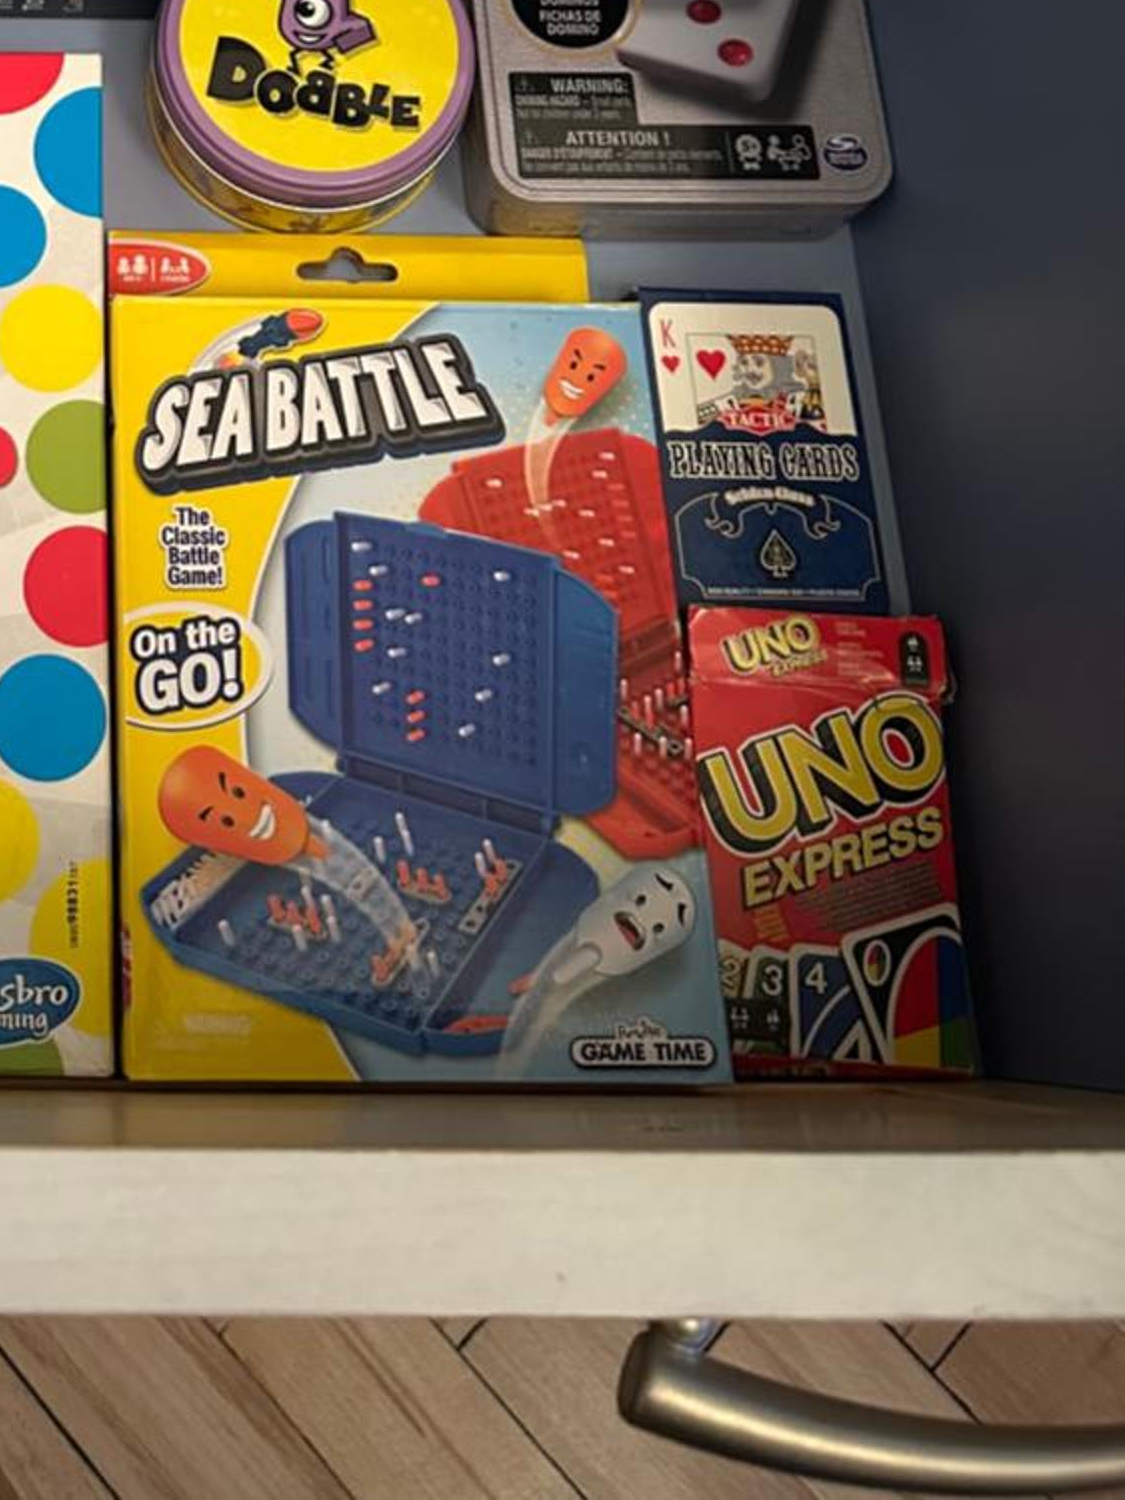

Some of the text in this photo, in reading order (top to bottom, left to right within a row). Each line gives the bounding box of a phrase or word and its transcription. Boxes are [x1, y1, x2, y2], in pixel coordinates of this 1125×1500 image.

[566, 131, 659, 146] ATTENTION
[660, 320, 675, 348] K
[142, 341, 487, 472] SEA BATTLE
[728, 411, 795, 428] TACTIC
[668, 441, 859, 481] PLAYING CARDS
[175, 507, 209, 525] The
[162, 526, 225, 545] Classic
[168, 546, 220, 565] Battle
[168, 566, 223, 585] Game!
[132, 618, 236, 660] On the
[722, 614, 816, 672] UNO
[138, 648, 241, 712] GO!
[699, 693, 944, 853] UNO
[744, 807, 944, 906] EXPRESS
[762, 965, 783, 996] 3
[805, 962, 827, 994] 4
[580, 1042, 706, 1062] GAME TIME
